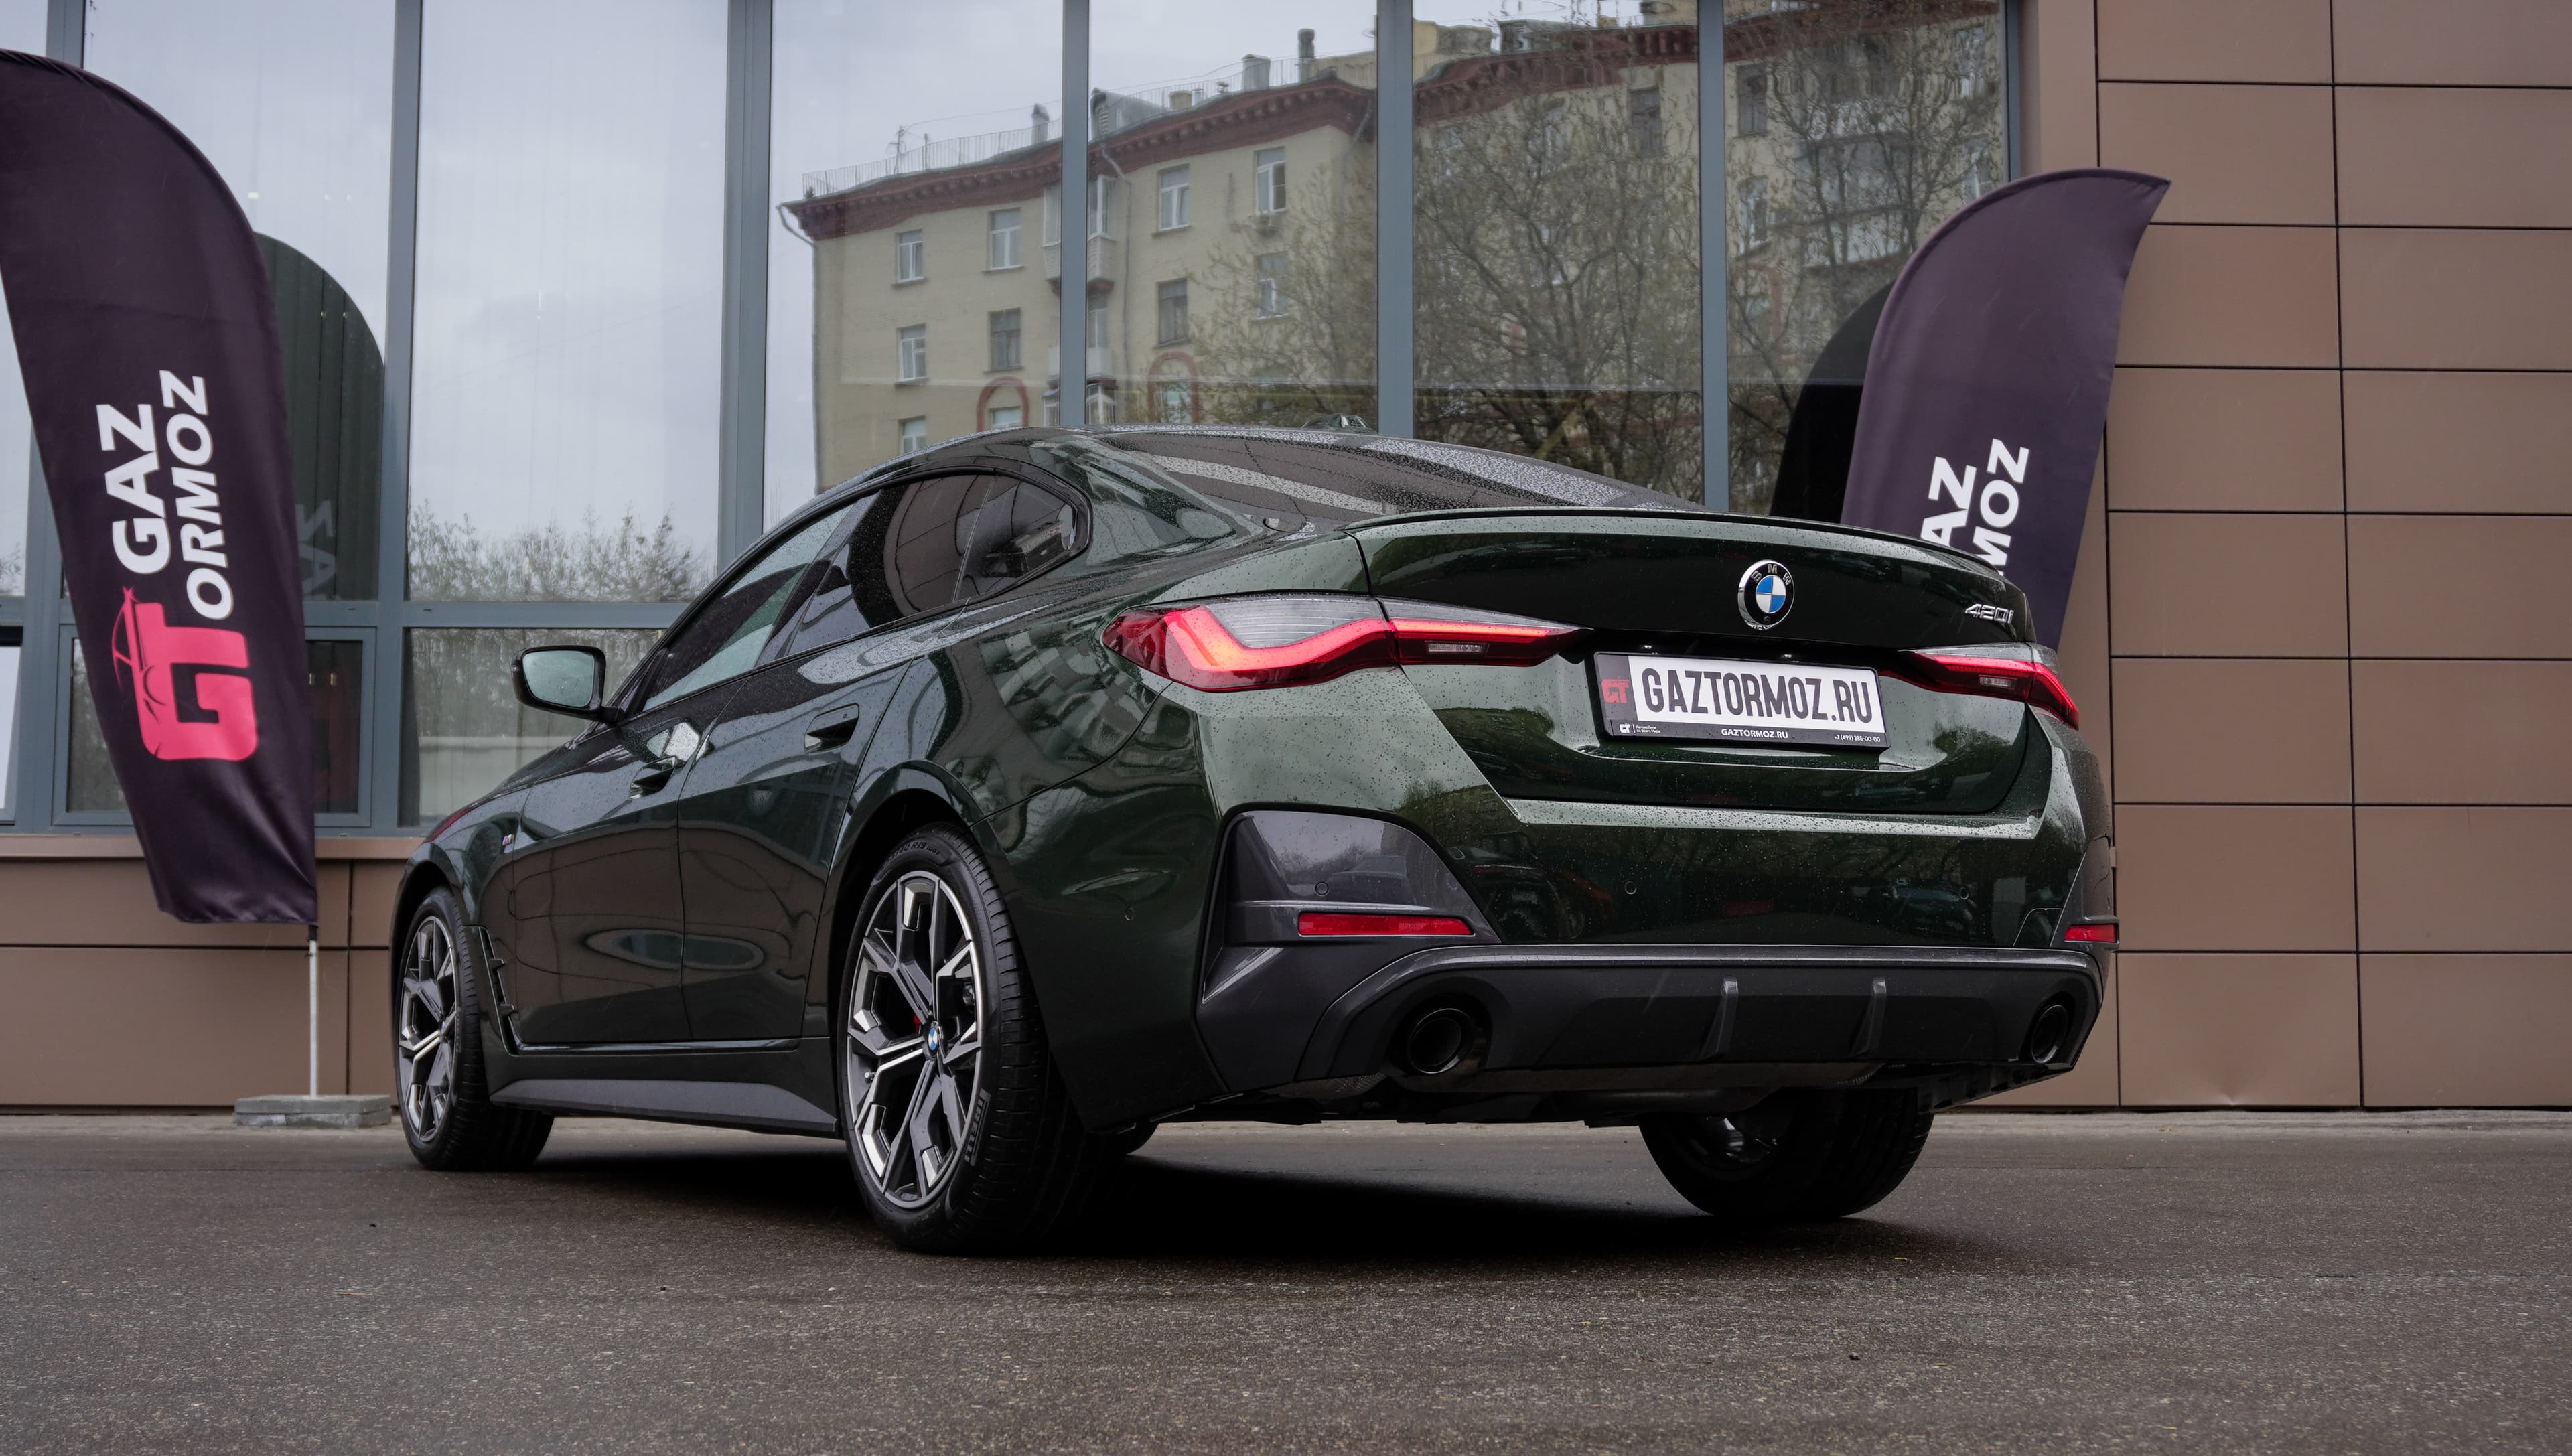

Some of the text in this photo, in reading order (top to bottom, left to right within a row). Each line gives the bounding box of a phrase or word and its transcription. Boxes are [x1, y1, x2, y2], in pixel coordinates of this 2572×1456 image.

[96, 404, 171, 574] GAZ
[159, 370, 234, 620] ORMOZ
[1973, 438, 2029, 576] MOZ
[1751, 564, 1792, 585] BMW
[1965, 603, 2014, 624] 420i
[1641, 667, 1873, 723] GAZTORMOZ.RU
[1721, 729, 1788, 739] GAZTORMOZ.RU
